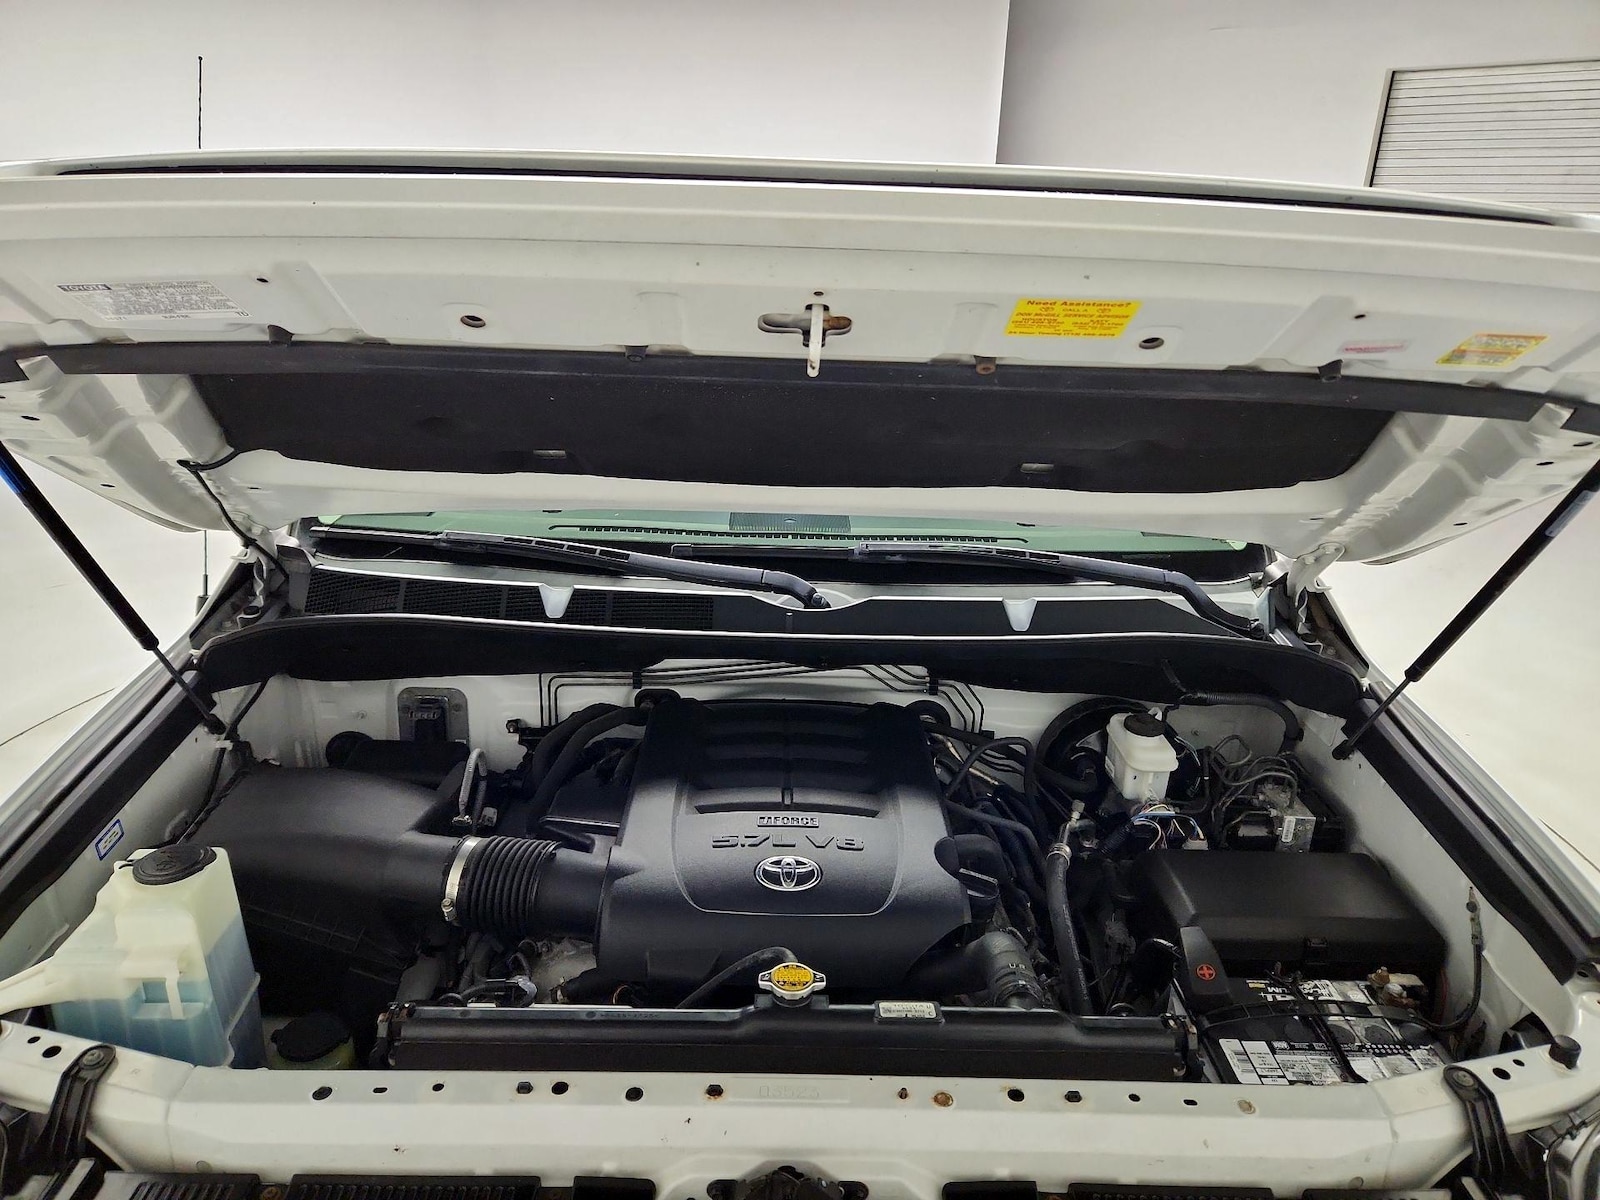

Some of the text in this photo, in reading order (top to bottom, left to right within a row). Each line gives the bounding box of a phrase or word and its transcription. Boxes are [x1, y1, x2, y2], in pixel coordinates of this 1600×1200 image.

[60, 284, 109, 292] TOYOTA
[711, 833, 865, 851] 5.7L V8
